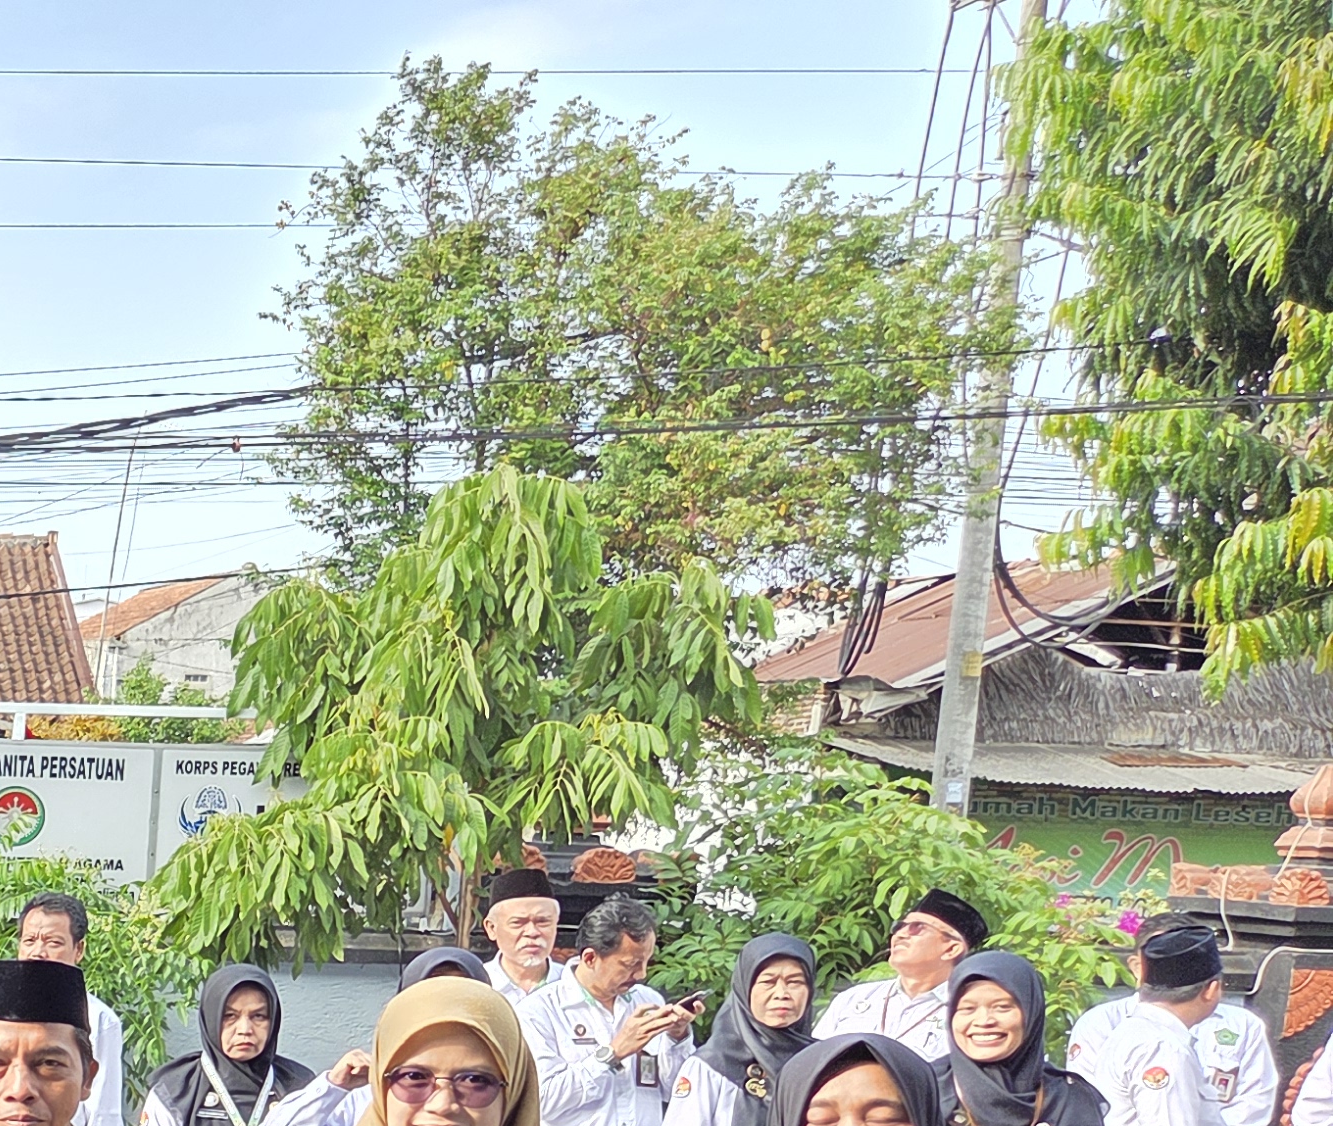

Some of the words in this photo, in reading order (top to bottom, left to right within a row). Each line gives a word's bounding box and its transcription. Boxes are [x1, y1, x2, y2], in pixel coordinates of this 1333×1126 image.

[40, 756, 126, 781] PERSATUAN
[176, 760, 218, 775] KORPS
[222, 761, 259, 776] PEGA
[970, 797, 1057, 817] umah
[1069, 796, 1181, 822] Makan
[1192, 801, 1294, 828] Leseh
